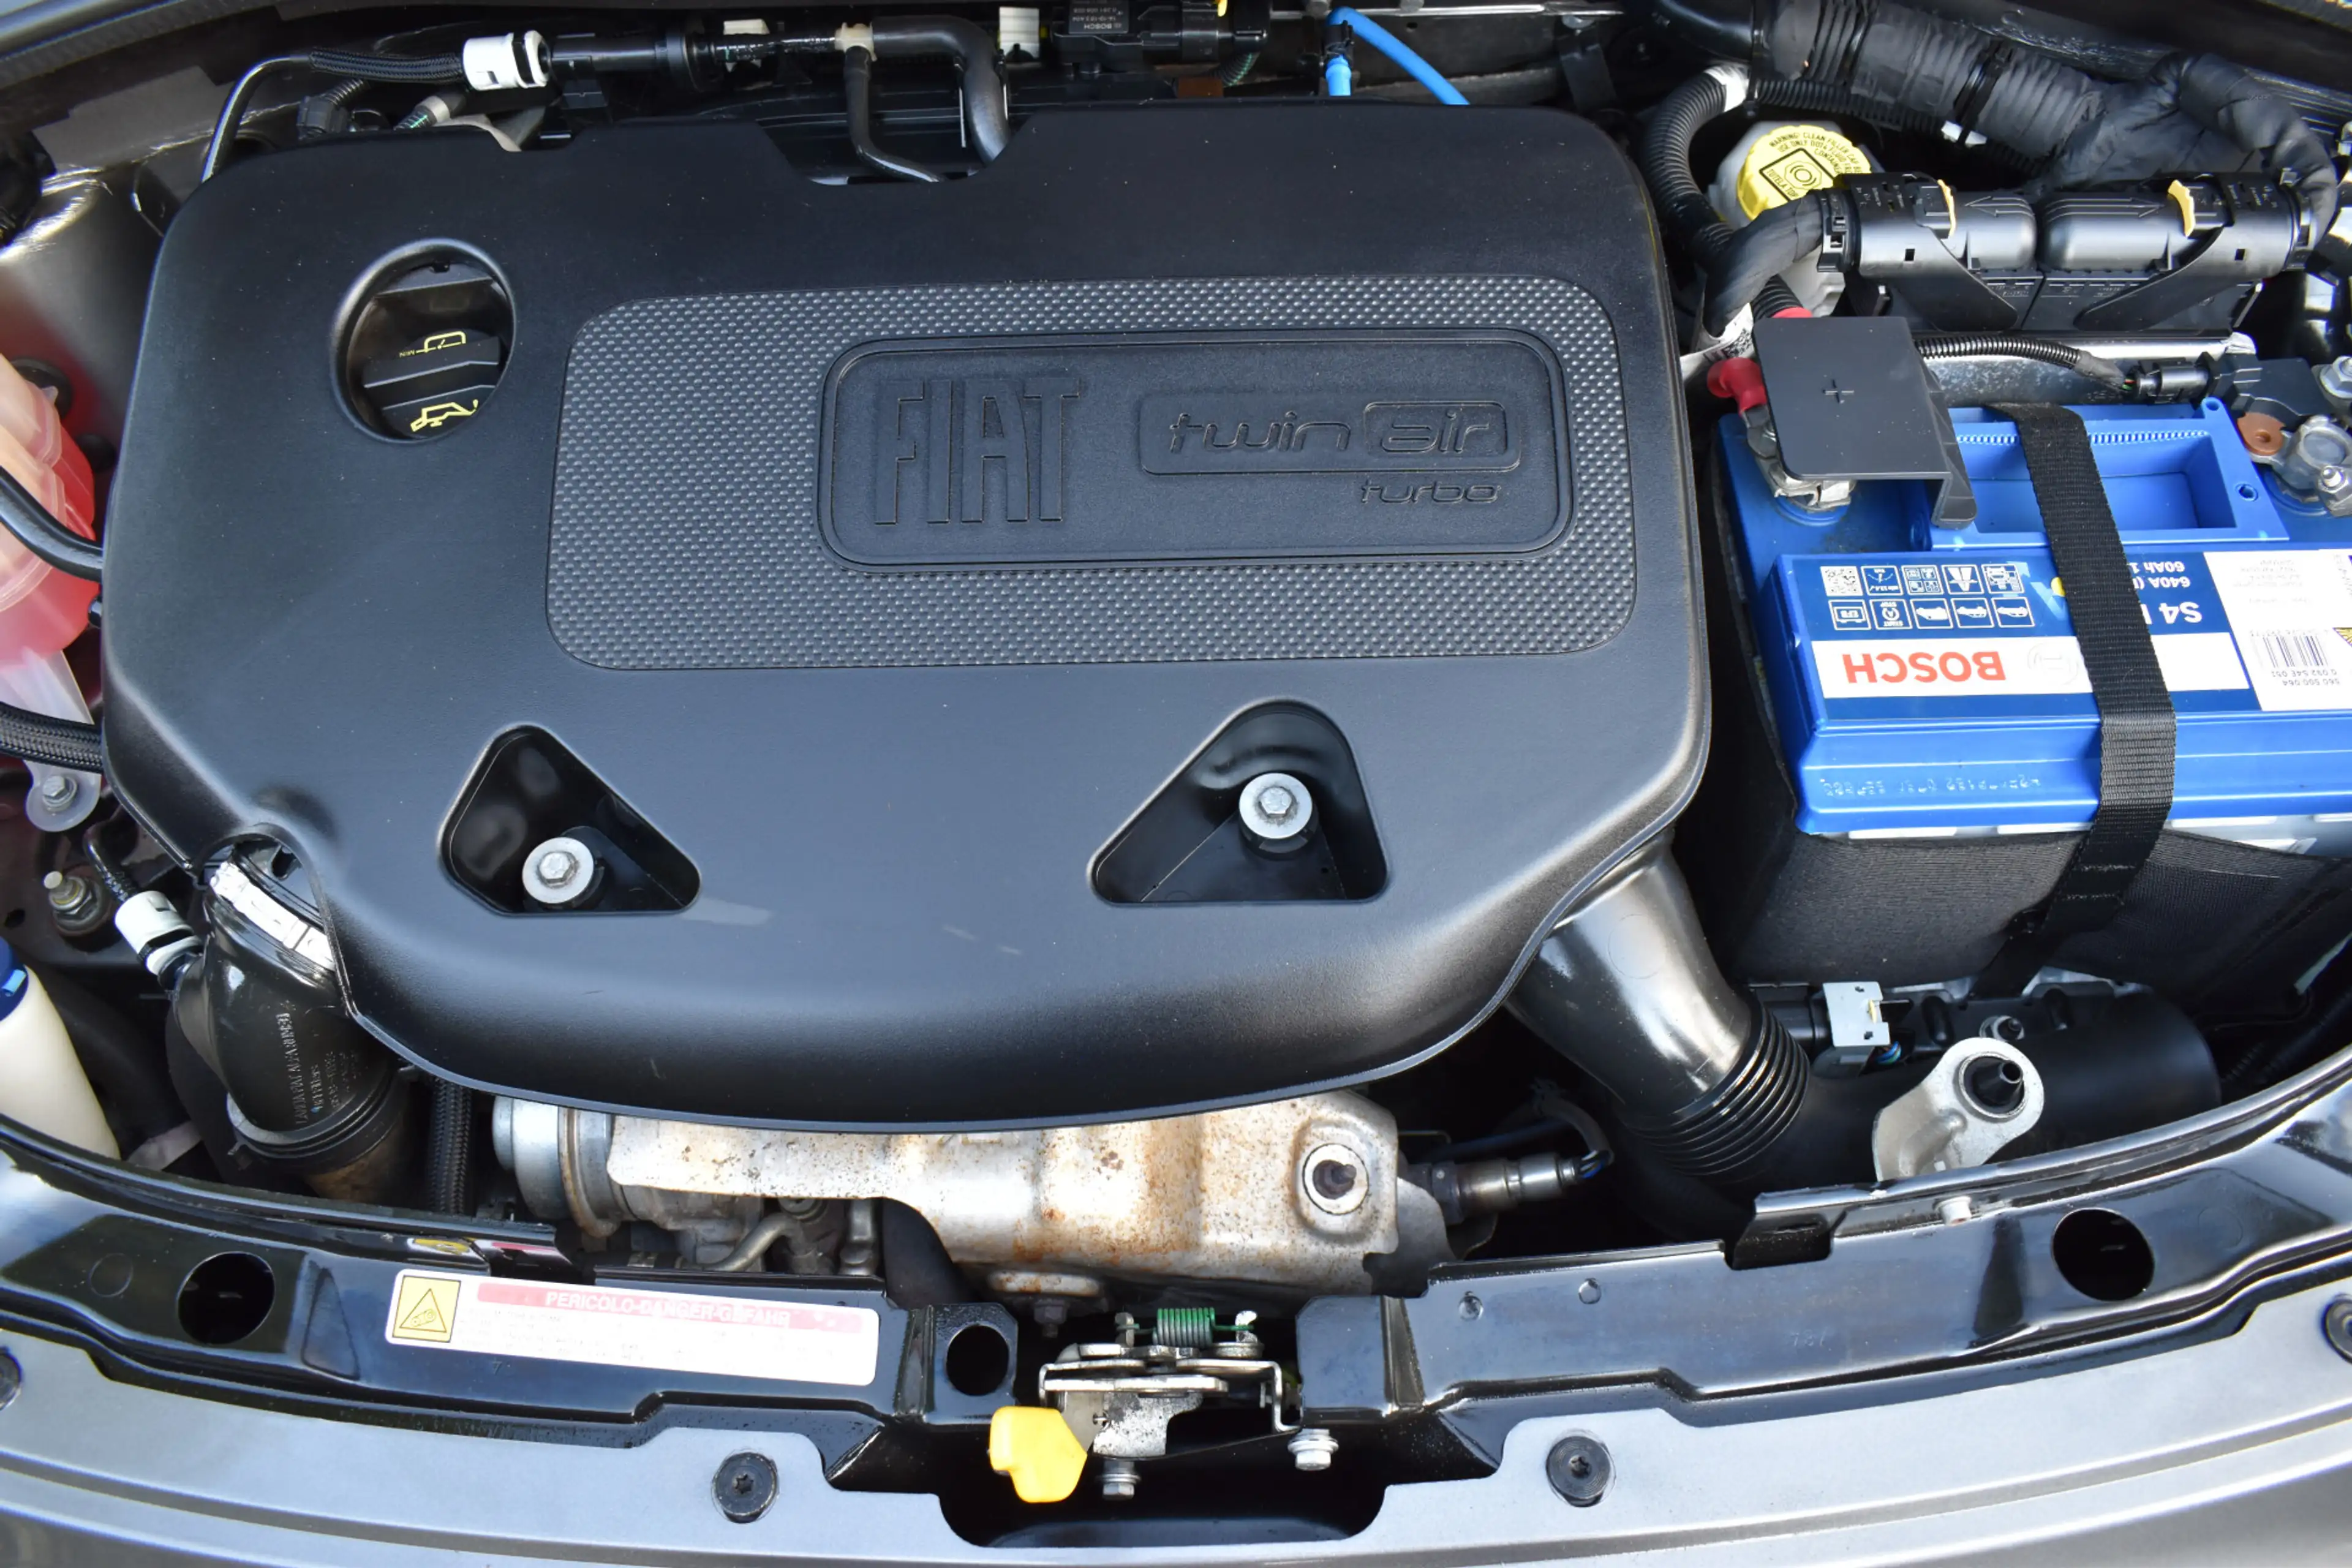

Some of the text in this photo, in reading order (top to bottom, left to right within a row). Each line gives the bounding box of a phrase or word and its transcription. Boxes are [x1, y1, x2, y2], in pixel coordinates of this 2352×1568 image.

[1803, 132, 1826, 141] CLEAN
[1768, 168, 1787, 189] TUTELA
[1170, 409, 1490, 453] twin air
[875, 378, 1082, 525] FIAT
[1361, 480, 1501, 504] turbo
[2143, 561, 2185, 573] 60Ah
[2147, 576, 2191, 589] 640A
[2158, 601, 2203, 624] S4
[1842, 650, 2007, 684] BOSCH
